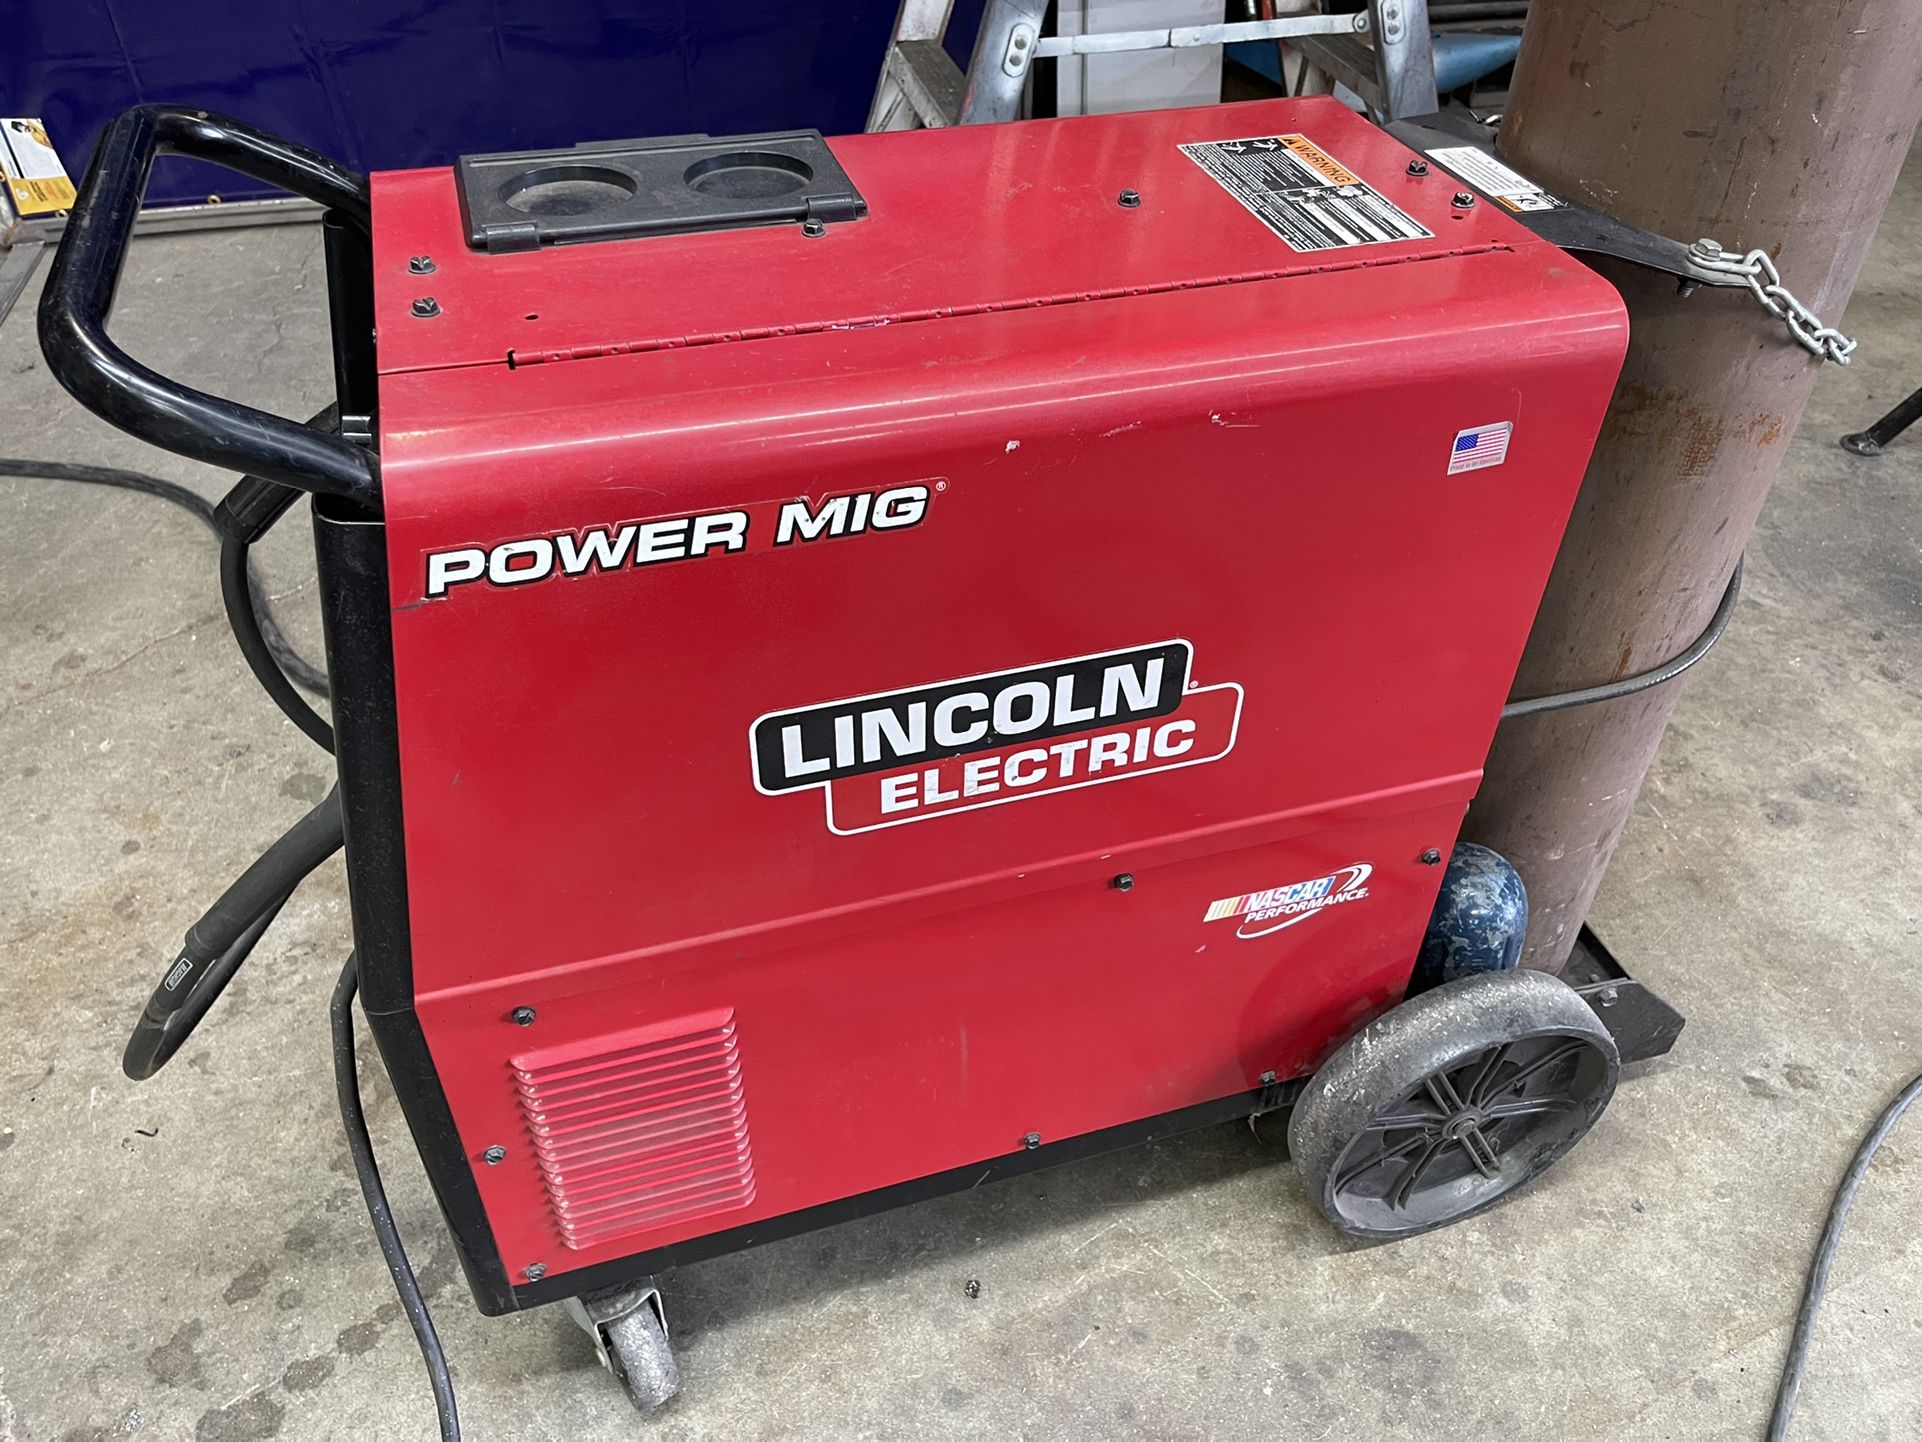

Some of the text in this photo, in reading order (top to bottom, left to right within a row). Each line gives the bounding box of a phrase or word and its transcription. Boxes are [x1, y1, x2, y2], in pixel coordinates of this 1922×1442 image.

[1295, 144, 1351, 183] WARNING
[427, 511, 748, 596] POWER
[781, 657, 1165, 778] LINCOLN
[880, 719, 1197, 814] ELECTRIC
[1245, 877, 1331, 912] NASCAR
